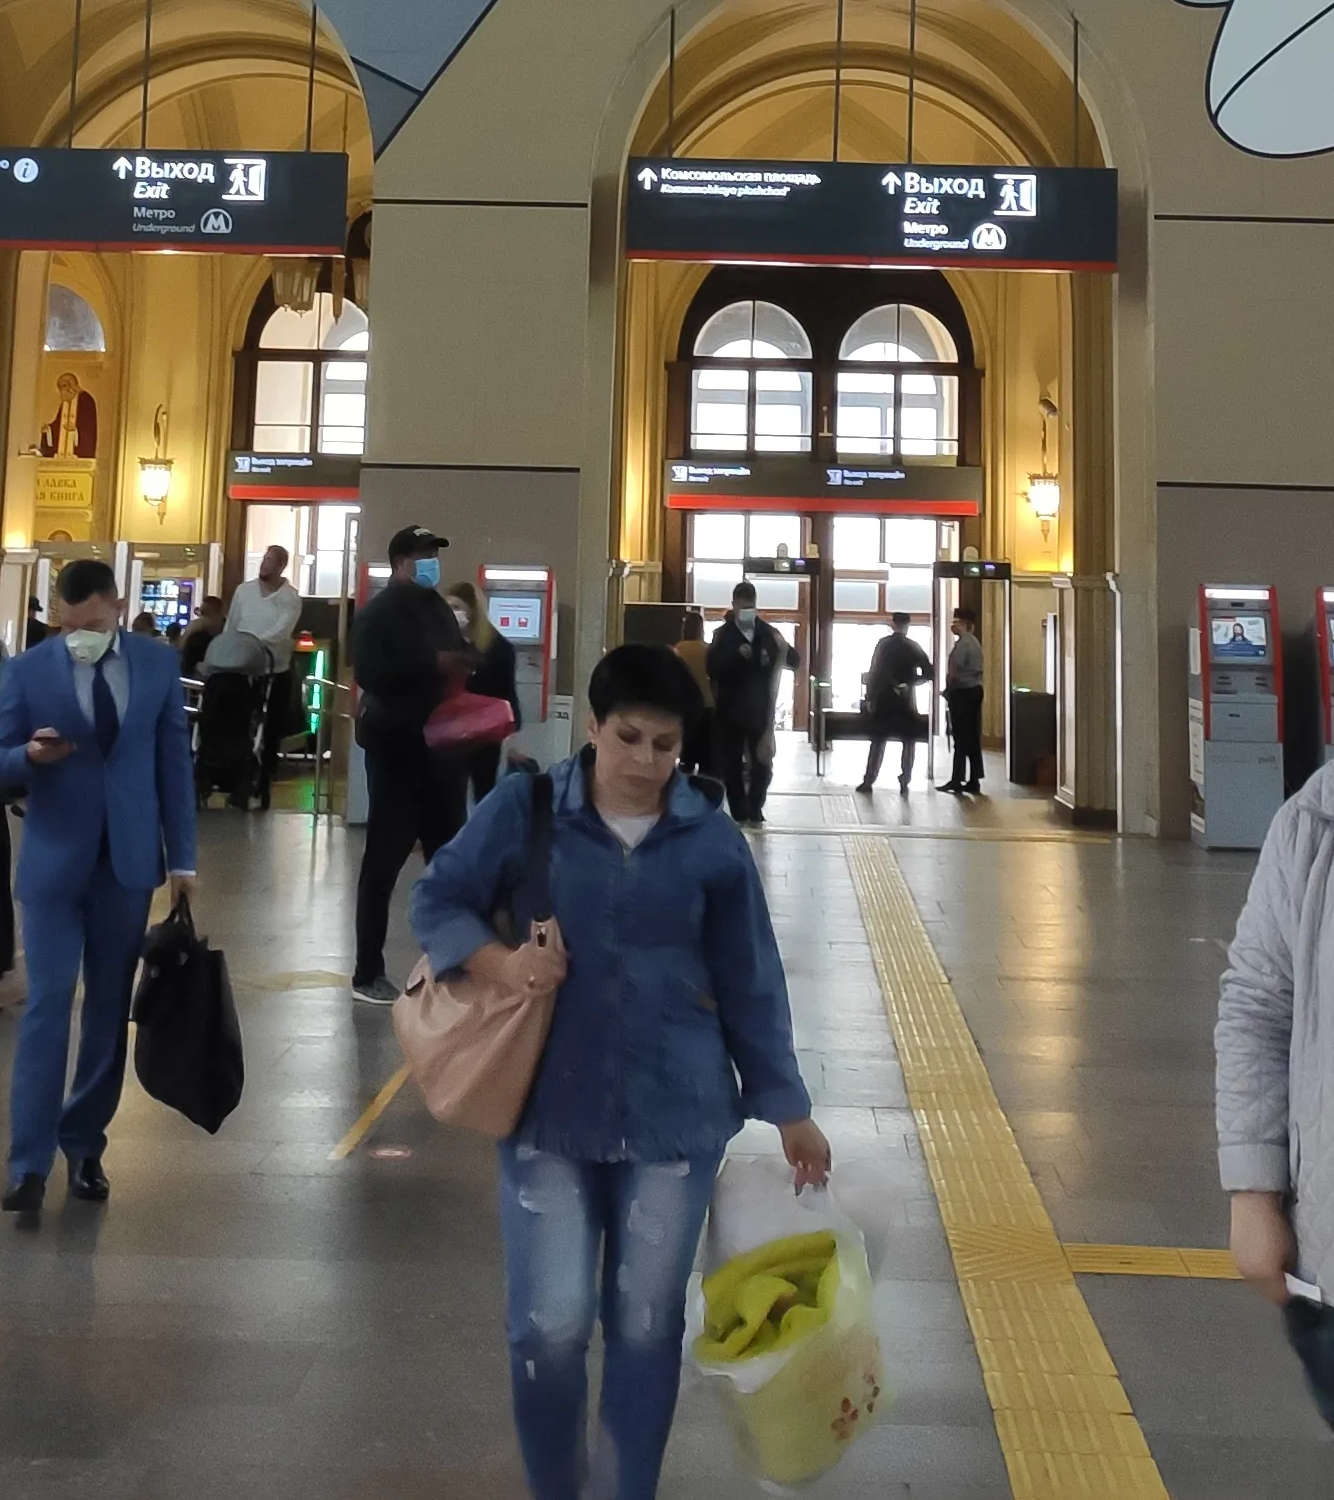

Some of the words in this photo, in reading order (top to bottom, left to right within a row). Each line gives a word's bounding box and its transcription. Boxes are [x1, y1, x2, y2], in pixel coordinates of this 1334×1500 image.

[135, 156, 215, 183] Выход
[661, 168, 762, 181] Комсомольская
[764, 172, 821, 185] площадь
[133, 182, 170, 199] Exit
[904, 171, 986, 199] Выход
[133, 206, 176, 220] Метро
[903, 197, 941, 214] Exit
[132, 223, 196, 234] Underground
[903, 221, 949, 237] Метро
[903, 238, 969, 250] Underground
